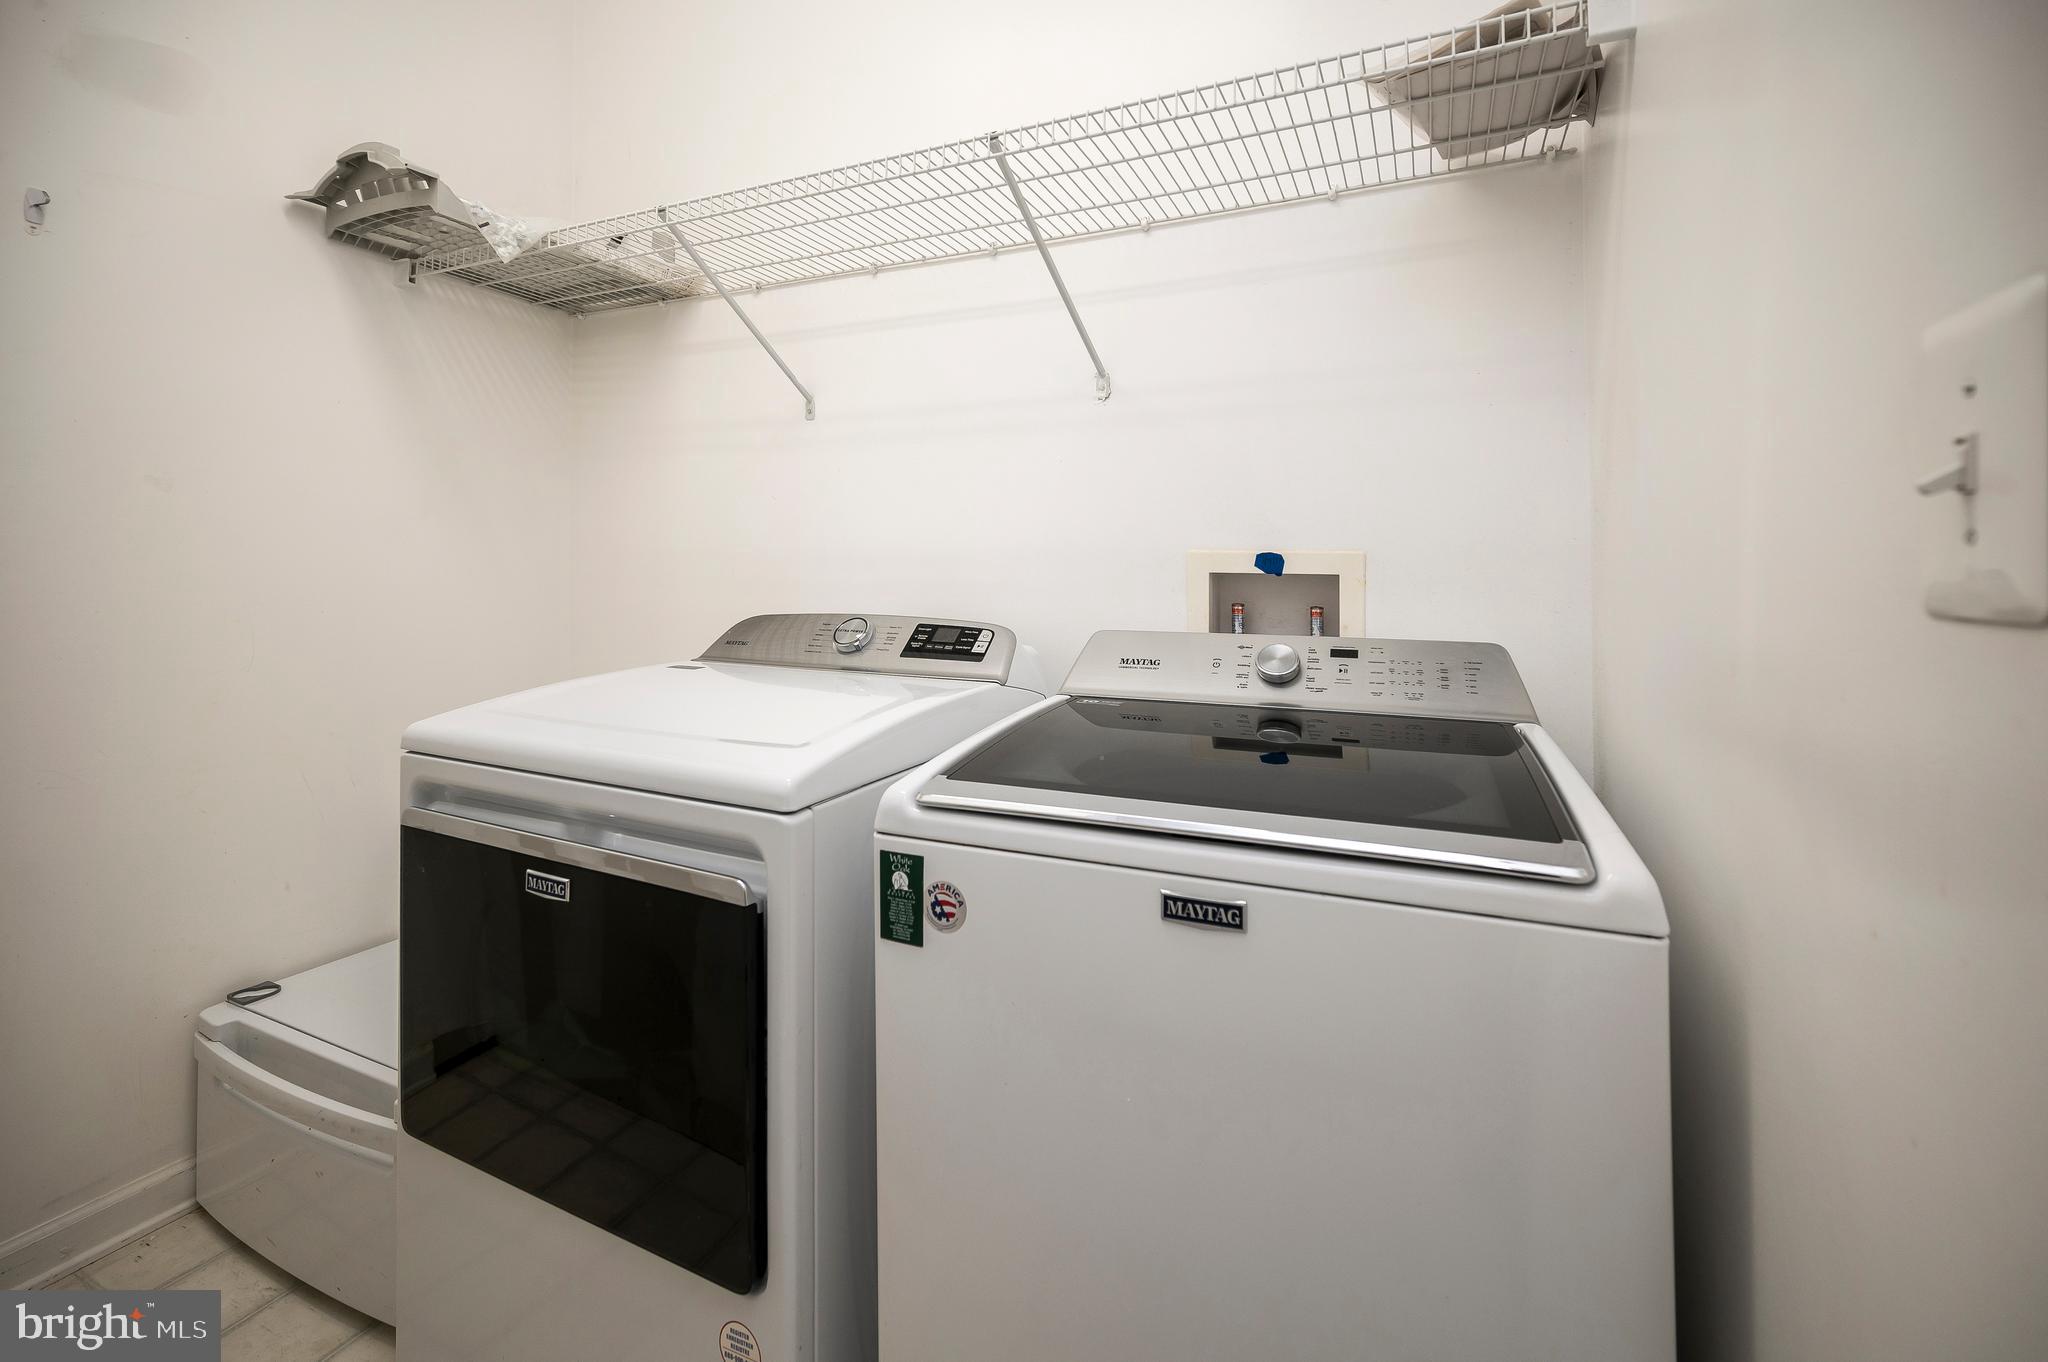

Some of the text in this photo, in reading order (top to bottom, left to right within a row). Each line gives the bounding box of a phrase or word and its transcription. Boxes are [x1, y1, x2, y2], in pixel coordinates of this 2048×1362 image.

[1119, 658, 1161, 667] MAYTAG
[889, 853, 913, 866] White
[891, 863, 911, 873] Oak
[528, 876, 565, 896] MAYTAG
[927, 883, 964, 908] AMERICA
[1166, 899, 1240, 925] MAYTAG
